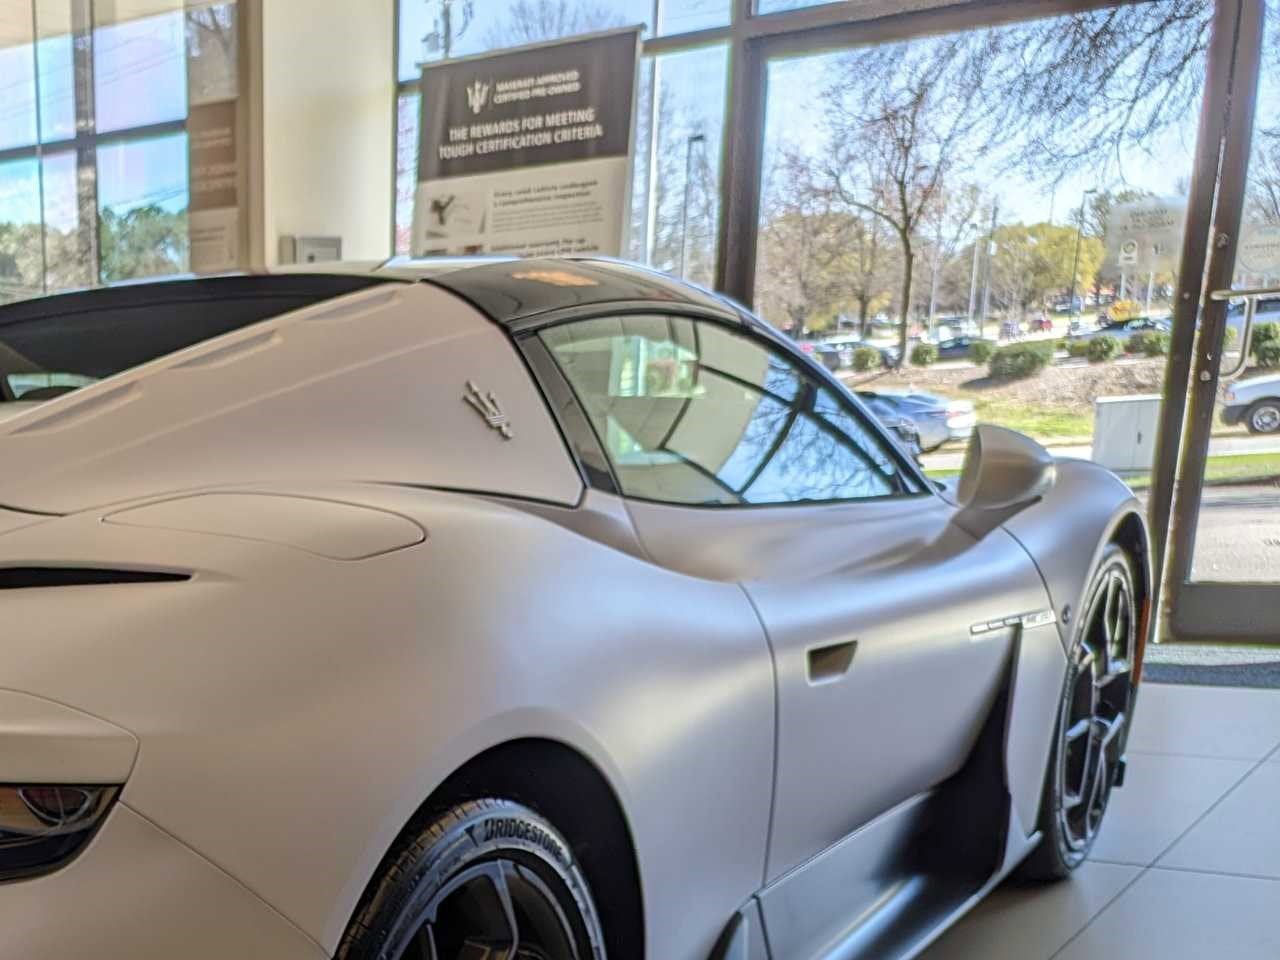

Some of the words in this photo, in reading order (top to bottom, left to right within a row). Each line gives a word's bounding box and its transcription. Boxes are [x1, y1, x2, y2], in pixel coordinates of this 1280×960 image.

[439, 143, 473, 160] TOUGH
[476, 131, 552, 154] CERTIFICATION
[554, 124, 603, 143] CRITERIA
[449, 128, 468, 142] THE
[470, 119, 520, 138] REWARDS
[522, 115, 543, 131] FOR
[545, 108, 595, 126] MEETING
[483, 818, 563, 859] BRIDGESTONE
